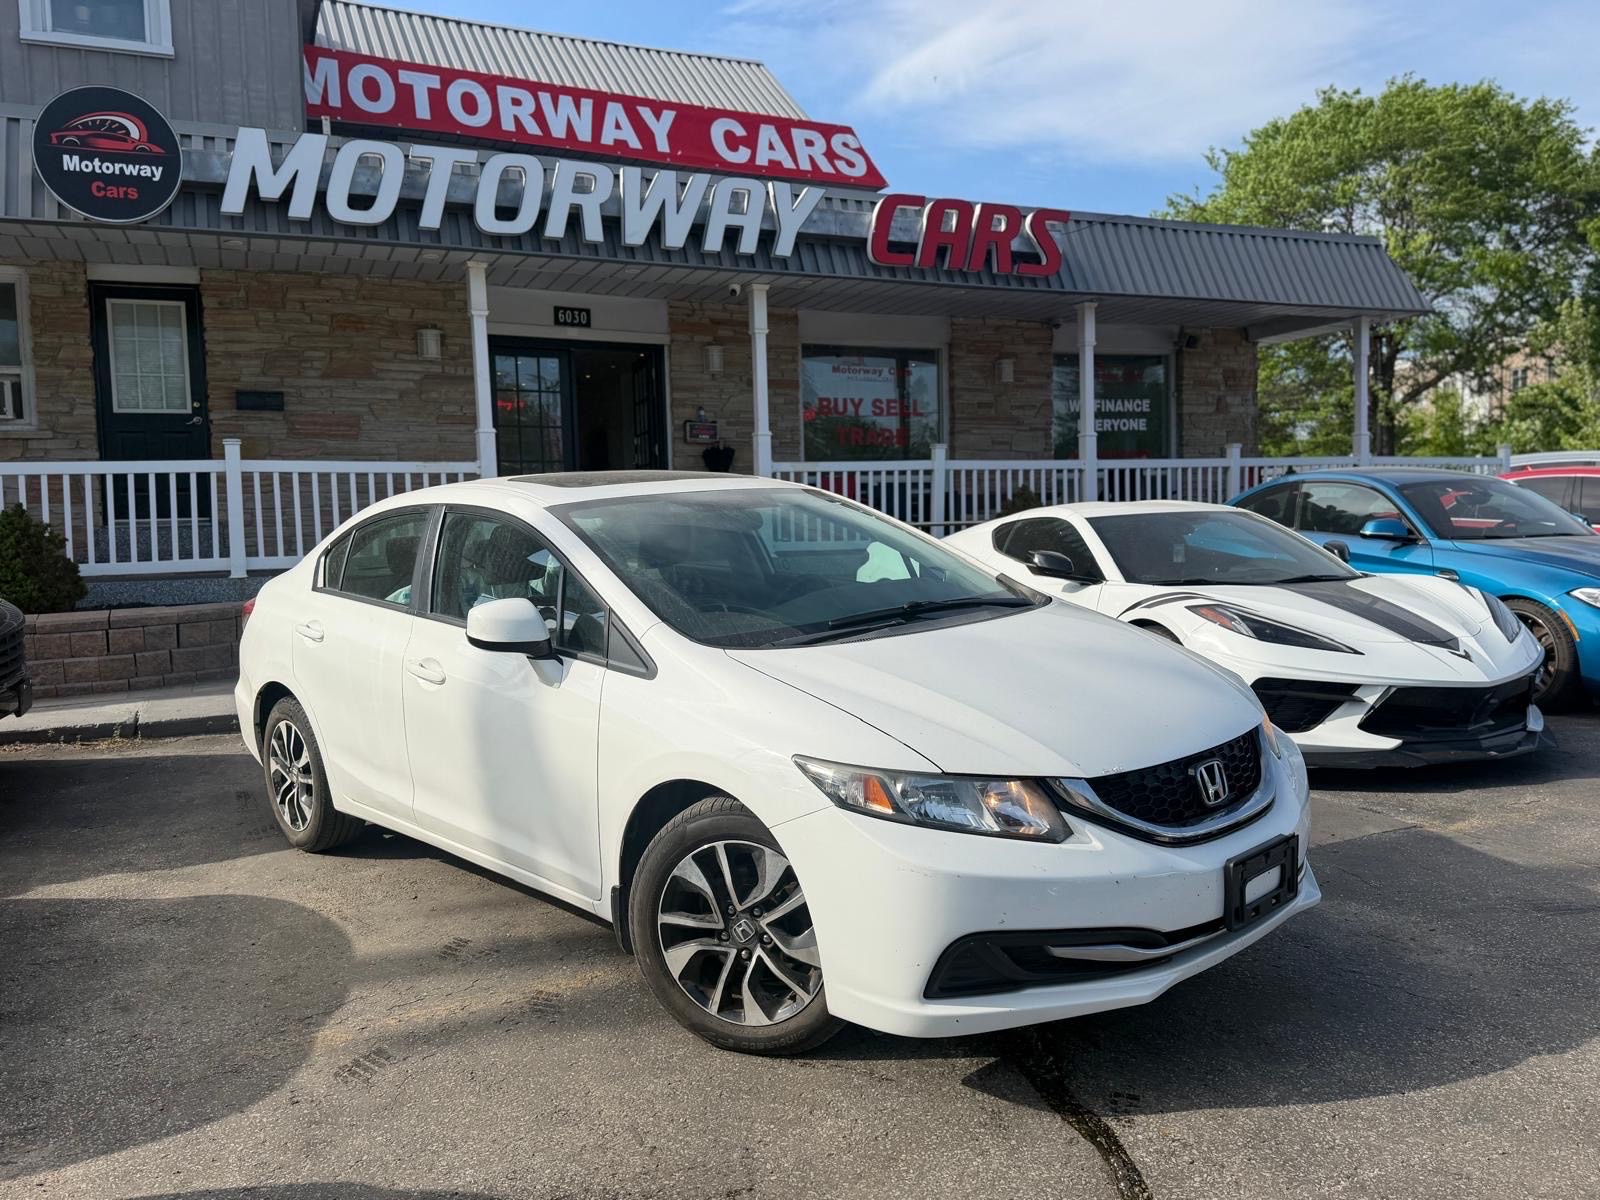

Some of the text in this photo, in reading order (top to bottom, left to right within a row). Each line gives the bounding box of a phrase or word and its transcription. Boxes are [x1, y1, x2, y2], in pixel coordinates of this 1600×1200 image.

[304, 54, 869, 179] MOTORWAY CARS
[62, 154, 164, 182] Motorway
[91, 181, 139, 200] Cars
[220, 126, 1071, 278] MOTORWAY CARS
[558, 309, 588, 325] 6030
[832, 364, 912, 377] Motorway Cs
[817, 396, 925, 417] BUY SELL
[1094, 398, 1151, 412] FINANCE
[1077, 418, 1147, 431] ERYONE
